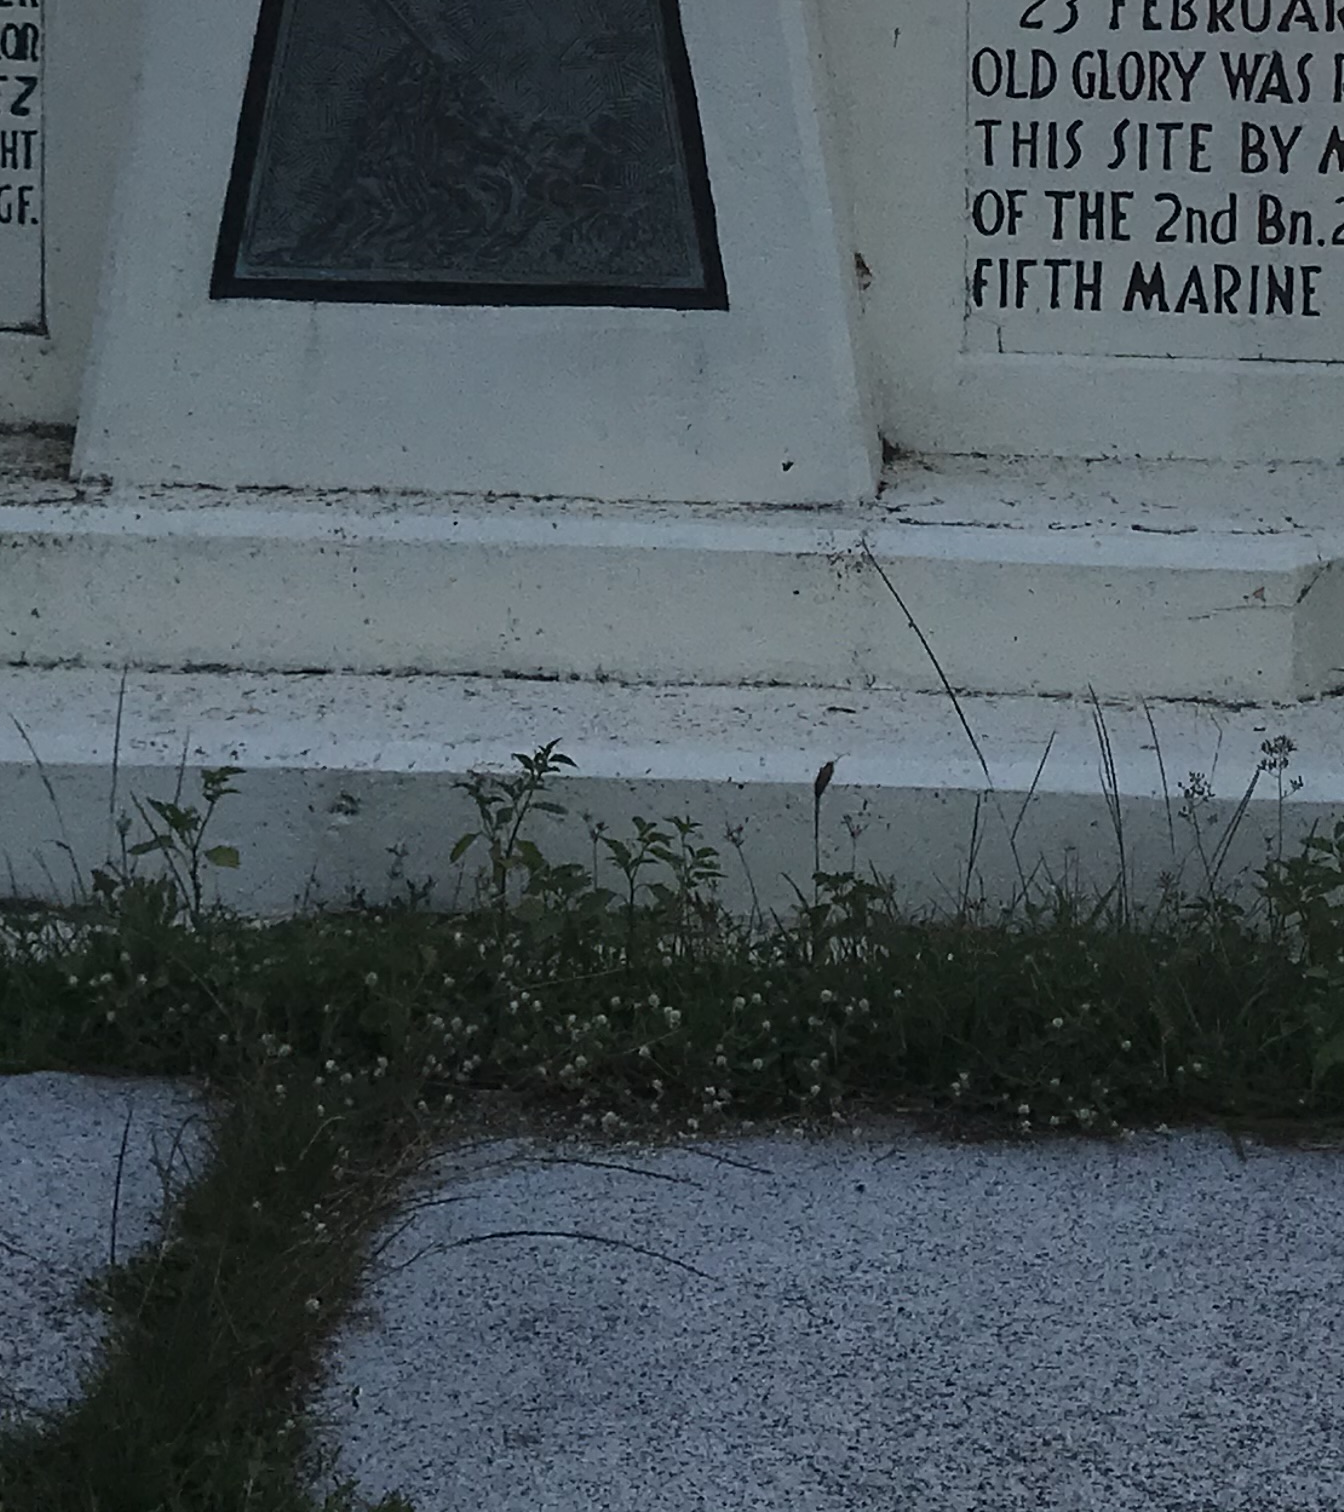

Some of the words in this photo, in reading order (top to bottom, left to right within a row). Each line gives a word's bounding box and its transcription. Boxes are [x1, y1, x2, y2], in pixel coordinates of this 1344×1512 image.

[972, 47, 1057, 99] OLD
[1072, 49, 1206, 102] GLORY
[1220, 50, 1313, 104] WAS
[974, 119, 1083, 169] THIS
[1107, 118, 1212, 172] SITE
[1241, 122, 1302, 174] BY
[972, 189, 1027, 236] OF
[1044, 190, 1134, 241] THE
[1155, 193, 1236, 244] 2nd
[972, 258, 1102, 311] FIFTH
[1122, 261, 1322, 316] MARINE
